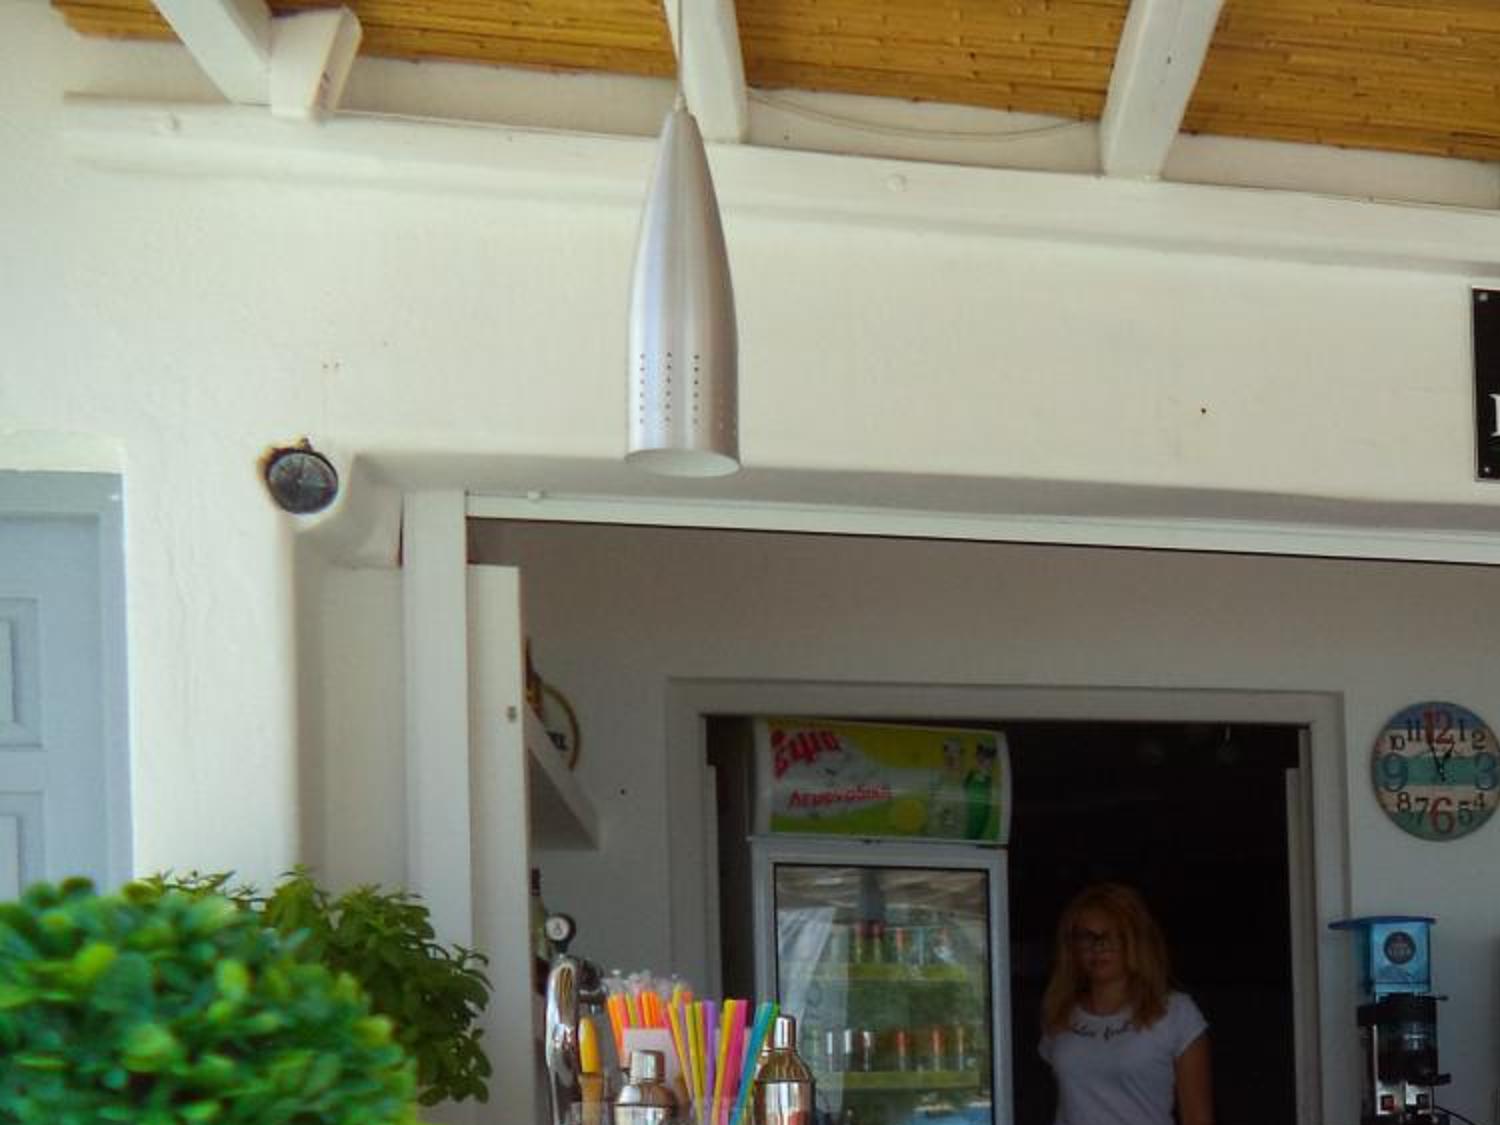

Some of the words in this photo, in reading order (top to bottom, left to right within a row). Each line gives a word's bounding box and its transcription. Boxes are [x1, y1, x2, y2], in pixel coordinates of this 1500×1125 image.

[1471, 728, 1486, 750] 2
[1384, 752, 1408, 792] 9
[1475, 752, 1499, 791] 3
[1397, 791, 1411, 813] 8
[1415, 796, 1429, 826] 7
[1429, 797, 1457, 836] 6
